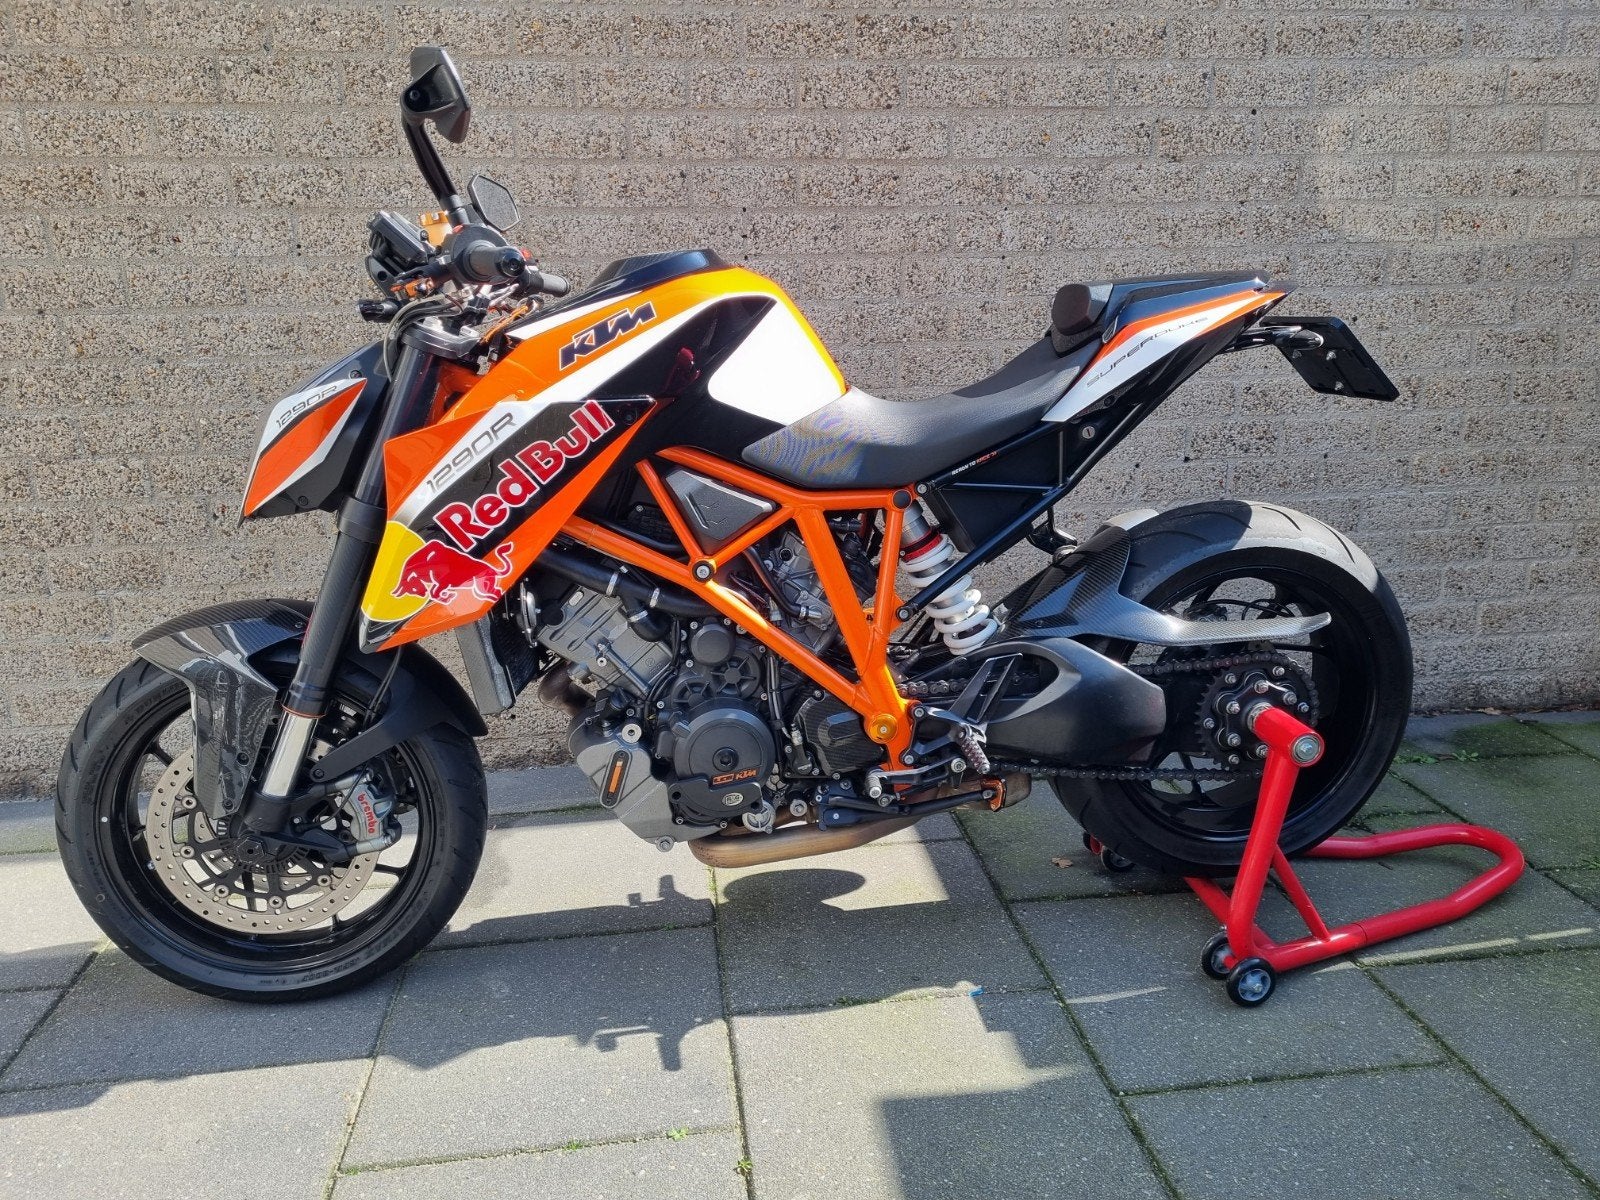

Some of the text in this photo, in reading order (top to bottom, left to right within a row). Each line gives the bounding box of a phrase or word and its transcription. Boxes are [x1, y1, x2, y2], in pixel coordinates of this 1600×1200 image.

[559, 301, 657, 371] KTM
[1087, 317, 1208, 387] SUPERDUKE
[276, 385, 337, 428] 1290R
[426, 412, 517, 494] 1290R
[432, 399, 616, 552] Red Bull
[358, 793, 378, 834] brembo
